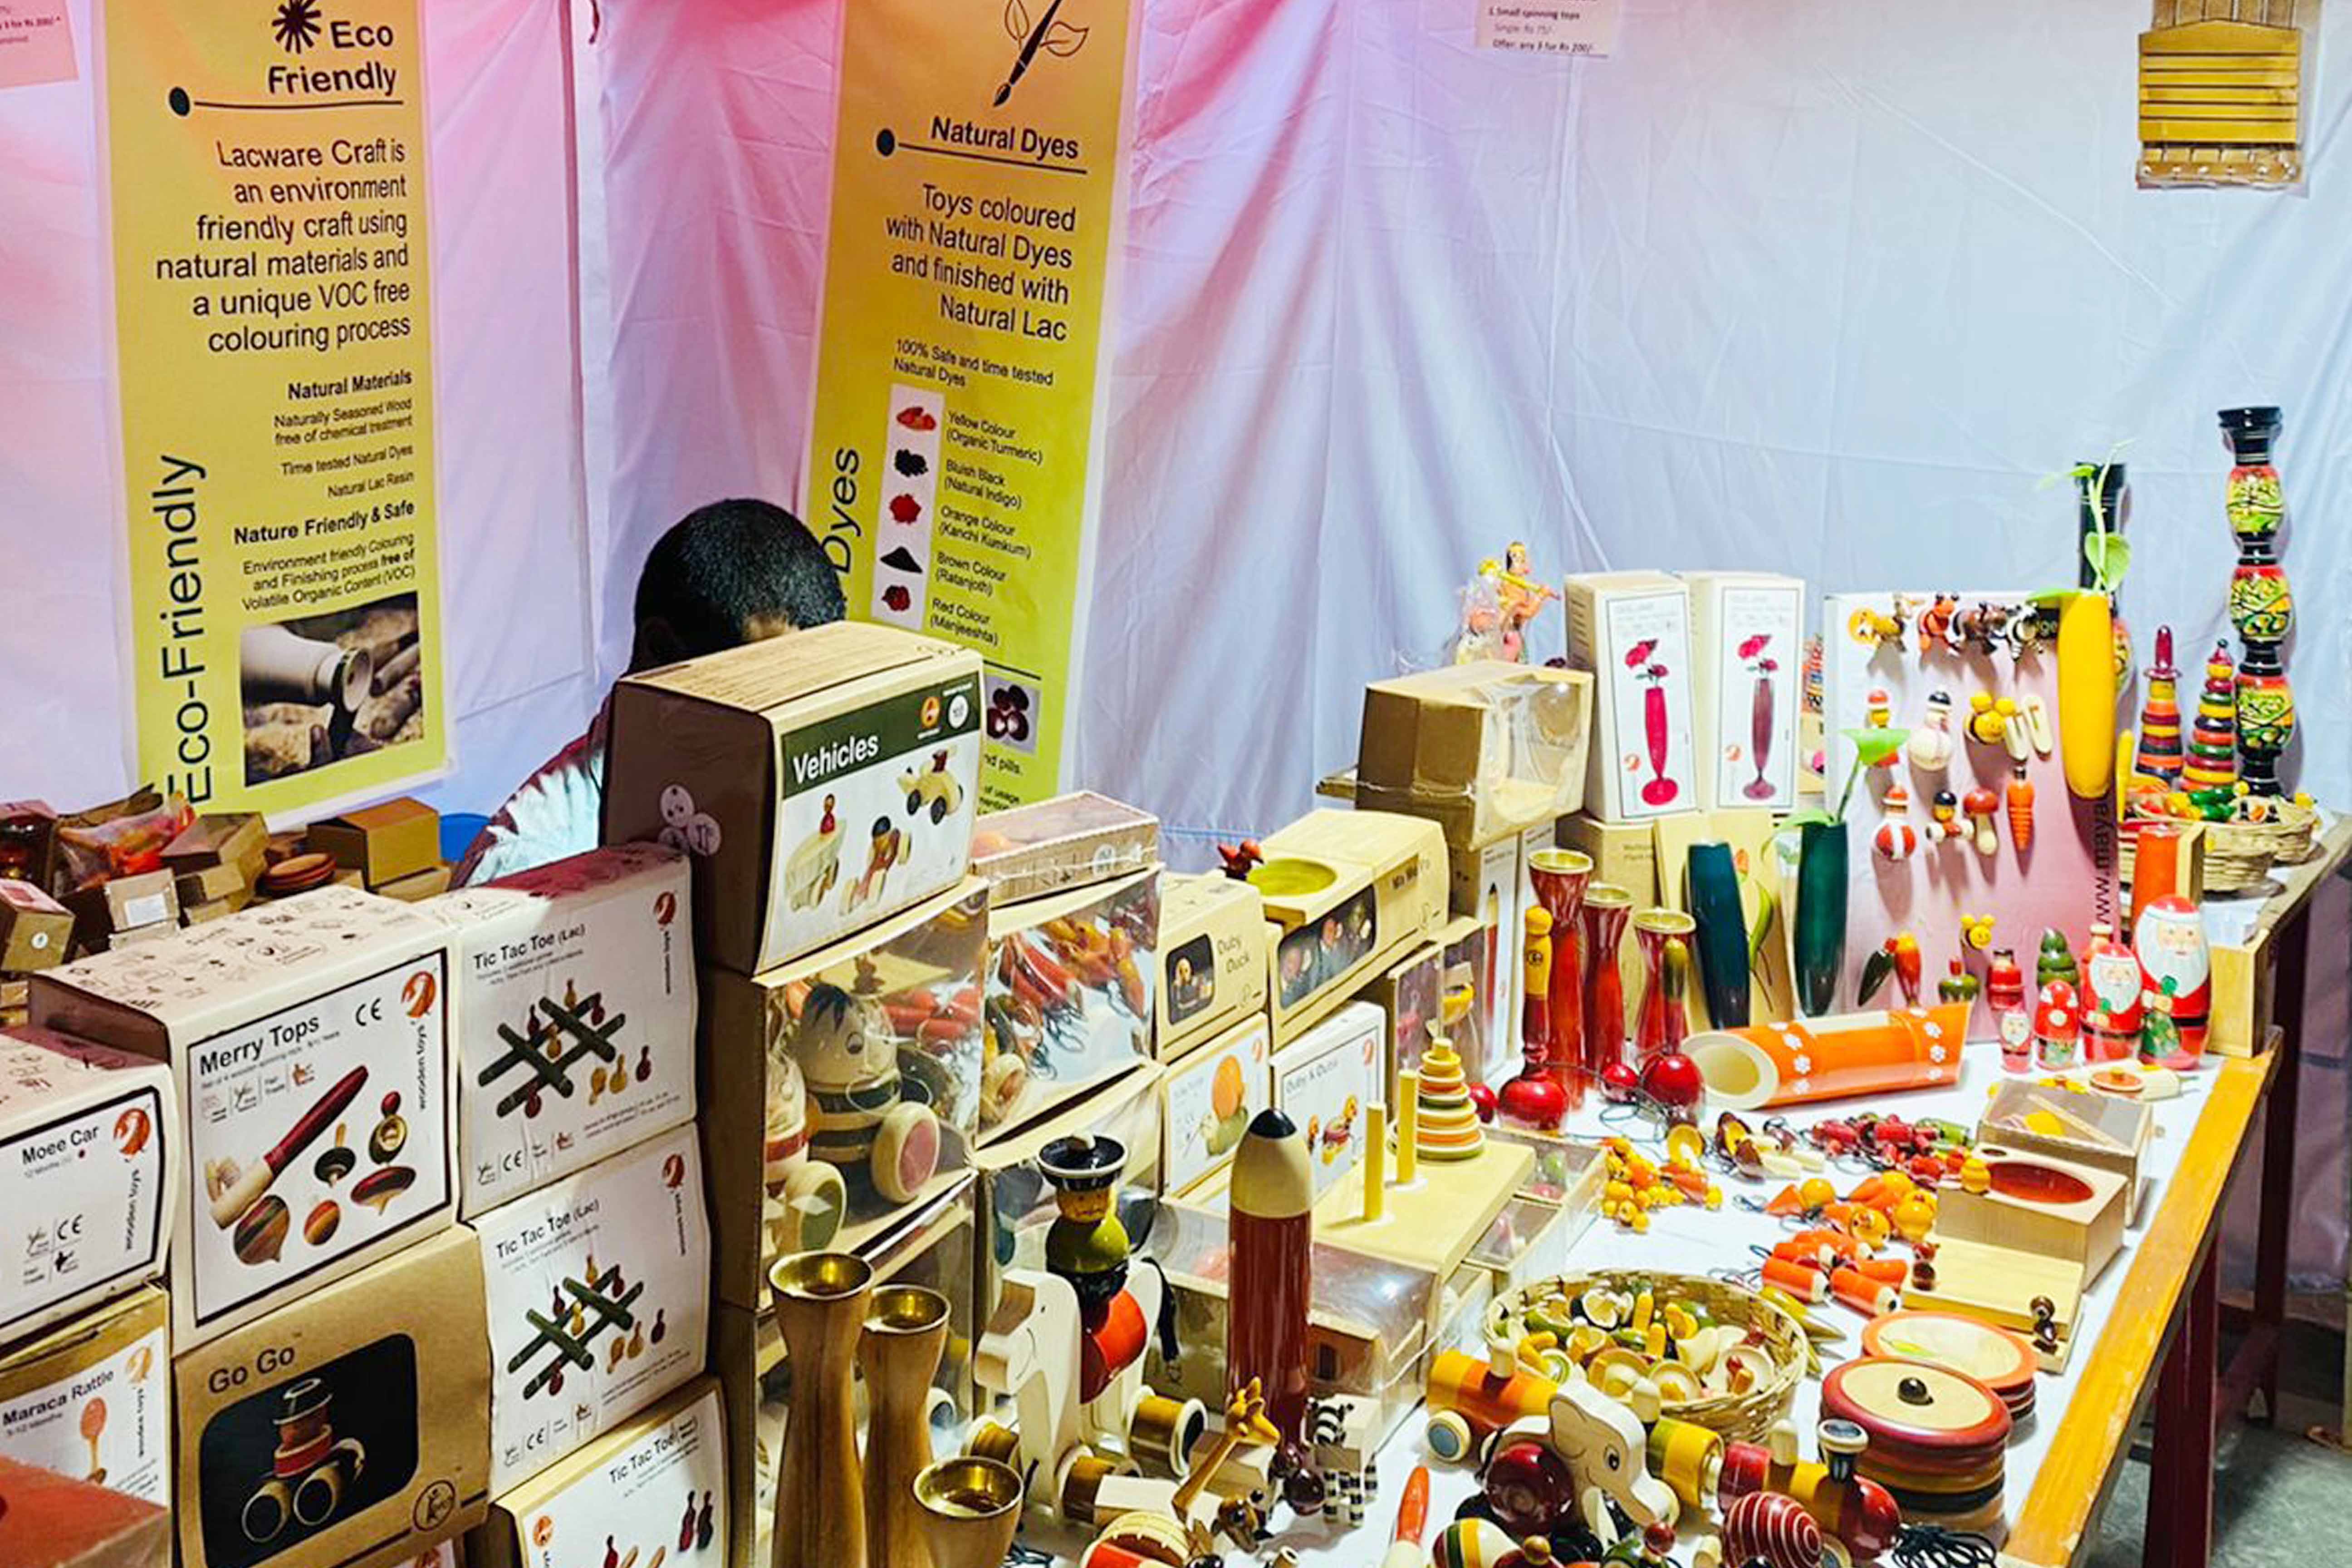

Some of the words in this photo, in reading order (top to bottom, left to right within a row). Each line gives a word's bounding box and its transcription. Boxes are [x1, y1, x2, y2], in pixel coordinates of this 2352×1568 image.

[330, 21, 393, 48] Eco
[269, 63, 396, 96] Friendly
[217, 140, 322, 167] Lacware
[332, 139, 386, 165] Craft
[391, 139, 405, 162] is
[931, 116, 1015, 151] Natural
[1020, 128, 1078, 161] Dyes
[235, 186, 263, 203] an
[271, 176, 406, 203] environment
[923, 183, 973, 218] Toys
[980, 197, 1076, 232] coloured
[197, 214, 294, 245] friendly
[304, 215, 353, 237] craft
[359, 212, 407, 237] using
[886, 215, 924, 244] with
[930, 222, 1006, 258] Natural
[1013, 235, 1072, 270] Dyes
[157, 252, 256, 279] natural
[267, 247, 367, 276] materials
[373, 245, 408, 269] and
[892, 253, 927, 278] and
[934, 257, 1014, 296] finished
[1022, 276, 1068, 305] with
[193, 297, 210, 315] a
[221, 289, 311, 318] unique
[319, 281, 367, 310] VOC
[374, 279, 409, 304] free
[208, 323, 329, 353] colouring
[337, 315, 411, 349] process
[940, 294, 1015, 332] Natural
[1023, 310, 1067, 342] Lac
[893, 358, 936, 381] Natural
[939, 366, 966, 387] Dyes
[896, 339, 928, 360] 100%
[932, 346, 955, 366] Safe
[959, 354, 979, 371] and
[982, 358, 1008, 377] time
[1012, 365, 1052, 386] tested
[289, 378, 348, 400] Natural
[353, 370, 412, 391] Materials
[274, 411, 331, 428] Naturally
[333, 403, 383, 422] Seasoned
[387, 398, 412, 412] Wood
[274, 432, 299, 445] free
[304, 428, 317, 443] of
[320, 422, 367, 441] chemical
[370, 416, 412, 433] treatment
[947, 411, 980, 430] Yellow
[981, 420, 1016, 439] Colour
[282, 460, 313, 475] Time
[316, 456, 350, 472] tested
[353, 448, 386, 466] Natural
[389, 445, 413, 461] Dyes
[946, 428, 989, 452] (Organic
[991, 440, 1043, 466] Turmeric)
[328, 481, 365, 498] Natural
[368, 475, 385, 491] Lac
[387, 471, 413, 486] Resin
[946, 459, 976, 478] Bluish
[979, 467, 1005, 486] Black
[821, 447, 862, 574] Dyes
[944, 476, 983, 497] (Natural
[986, 486, 1022, 510] Indigo)
[235, 525, 299, 544] Nature
[305, 510, 369, 536] Friendly
[372, 507, 380, 523] &
[385, 500, 414, 519] Safe
[939, 522, 979, 545] (Kanchi
[941, 505, 979, 528] Orange
[982, 518, 1015, 536] Colour
[243, 551, 327, 575] Environment
[330, 543, 366, 562] friendly
[369, 534, 413, 553] Colouring
[253, 575, 277, 591] and
[282, 567, 339, 588] Finishing
[342, 559, 378, 581] process
[381, 554, 401, 567] free
[404, 548, 414, 561] of
[937, 552, 970, 572] Brown
[972, 562, 1006, 582] Colour
[242, 590, 289, 612] Volatile
[293, 583, 342, 604] Organic
[344, 574, 382, 593] Content
[384, 565, 416, 585] (VOC)
[152, 454, 211, 804] Eco-Friendly
[932, 598, 954, 615] Red
[956, 604, 990, 625] Colour
[793, 732, 880, 785] Vehicles
[473, 952, 496, 969] Tic
[500, 943, 527, 960] Tac
[530, 934, 554, 951] Toe
[558, 923, 585, 945] (Lac)
[199, 1039, 264, 1076] Merry
[269, 1017, 319, 1049] Tops
[21, 1140, 67, 1166] Moee
[70, 1125, 100, 1147] Car
[503, 1150, 522, 1171] CE
[57, 1214, 83, 1240] CE
[496, 1239, 518, 1258] Tic
[520, 1227, 545, 1245] Tac
[547, 1212, 571, 1231] Toe
[207, 1363, 249, 1394] Go
[256, 1346, 295, 1375] Go
[2, 1394, 67, 1426] Maraca
[71, 1370, 114, 1399] Rattle
[527, 1427, 544, 1450] CE
[609, 1465, 628, 1483] Tic
[630, 1450, 652, 1469] Tac
[654, 1433, 675, 1453] Toe
